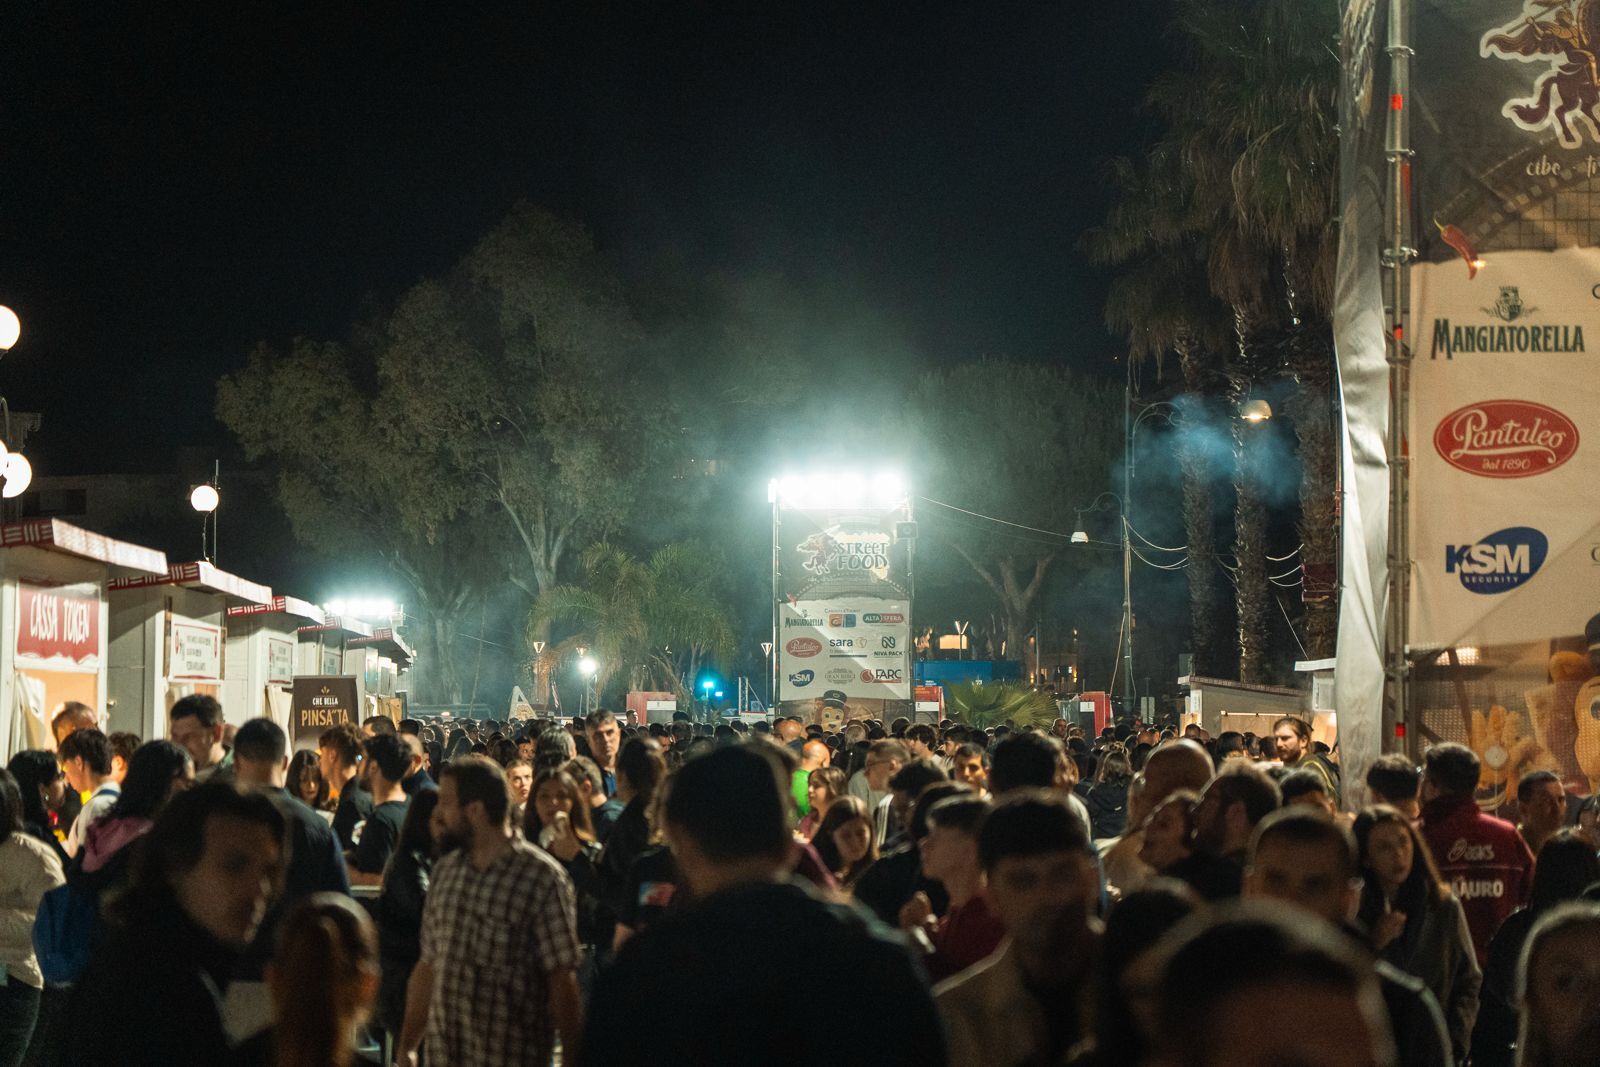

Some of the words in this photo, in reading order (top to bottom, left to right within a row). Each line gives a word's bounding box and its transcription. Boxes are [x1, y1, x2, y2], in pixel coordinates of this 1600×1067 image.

[1431, 318, 1585, 360] MANGIATORELLA
[1450, 409, 1567, 460] Pantaleo
[1502, 457, 1530, 470] 1890
[837, 554, 888, 570] FOOD
[1445, 543, 1530, 575] KSM
[1464, 575, 1519, 584] SECURITY
[30, 592, 58, 642] CASSA
[63, 599, 90, 646] TOKEN
[829, 638, 854, 647] sara
[875, 668, 902, 680] FARC
